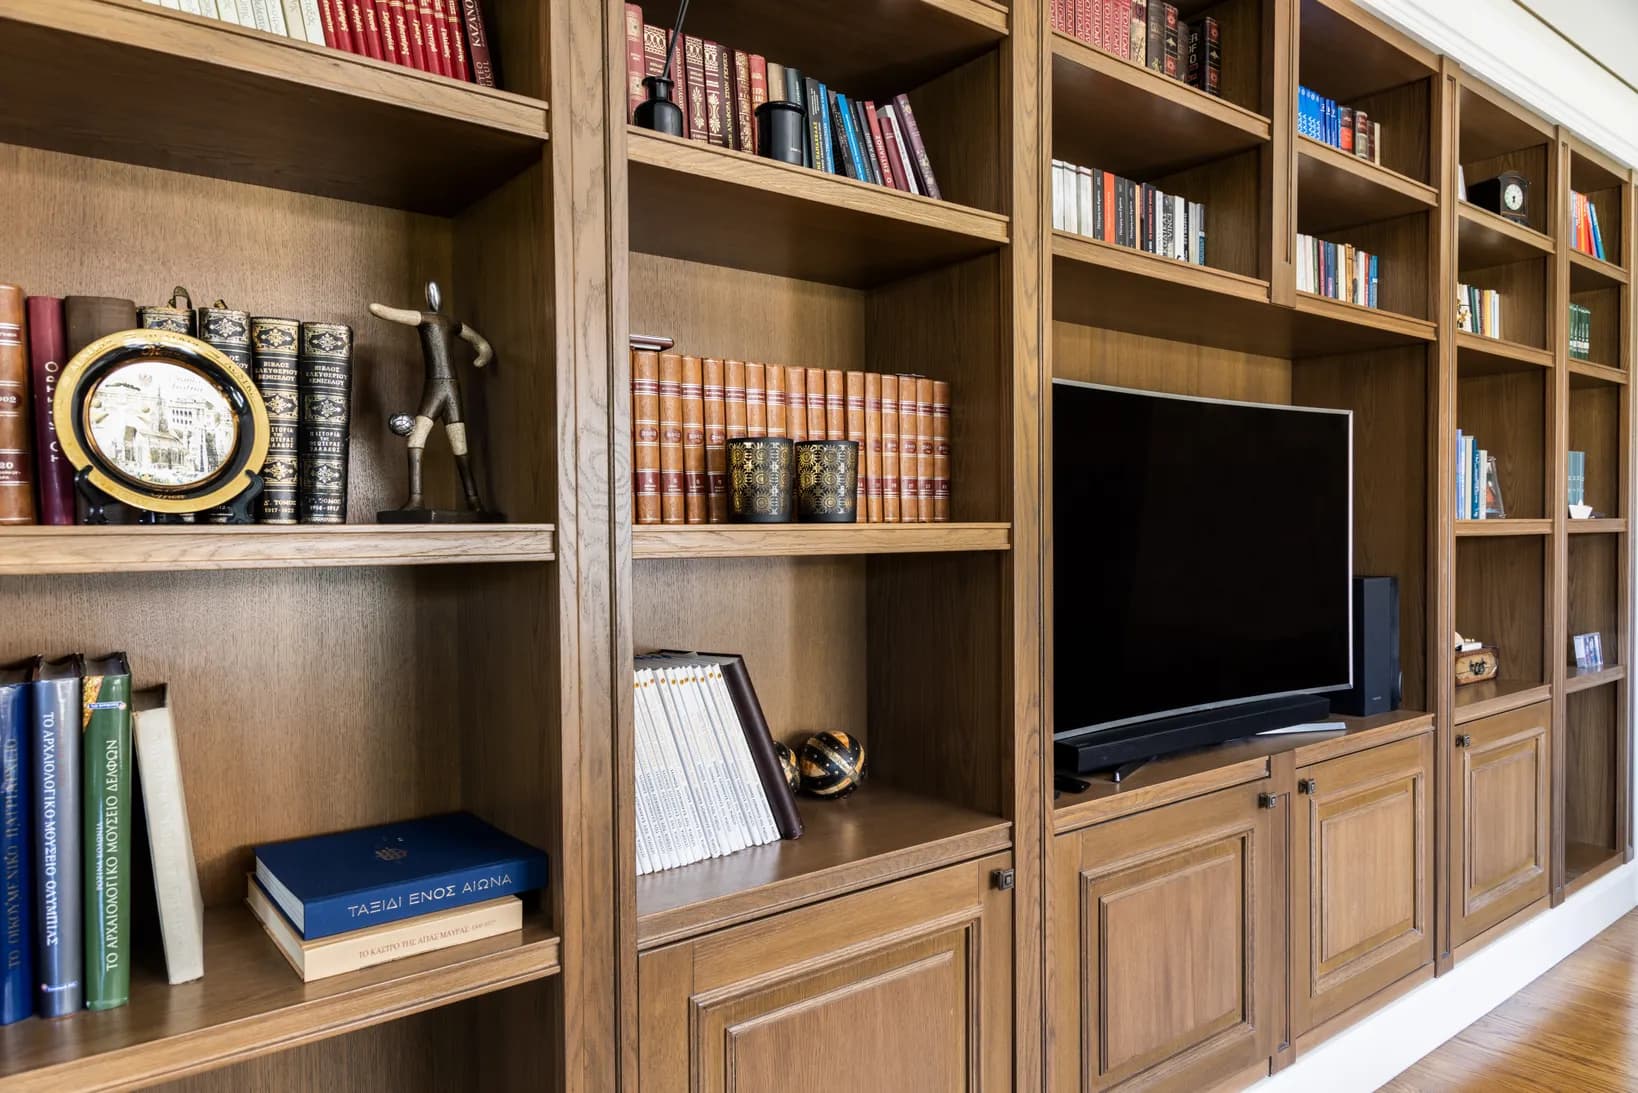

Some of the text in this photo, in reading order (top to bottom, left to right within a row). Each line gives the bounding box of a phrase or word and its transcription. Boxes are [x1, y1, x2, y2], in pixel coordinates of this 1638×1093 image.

[42, 711, 59, 946] ΤΟ ΑΡΧΑΙΟΛΟΓΙΚΟ ΜΟΥΣΕΙΟ ΟΛΥΜΠΙΑΣ
[105, 739, 119, 972] ΤΟ ΑΡΧΑΙΟΛΟΓΙΚΟ ΜΟΥΣΕΙΟ ΔΕΛΦΩΝ
[347, 873, 512, 918] ΤΑΞΙΔΙ ΕΝΟΣ ΑΙΩΝΑ
[370, 943, 400, 956] ΚΑΣΤΡΟ
